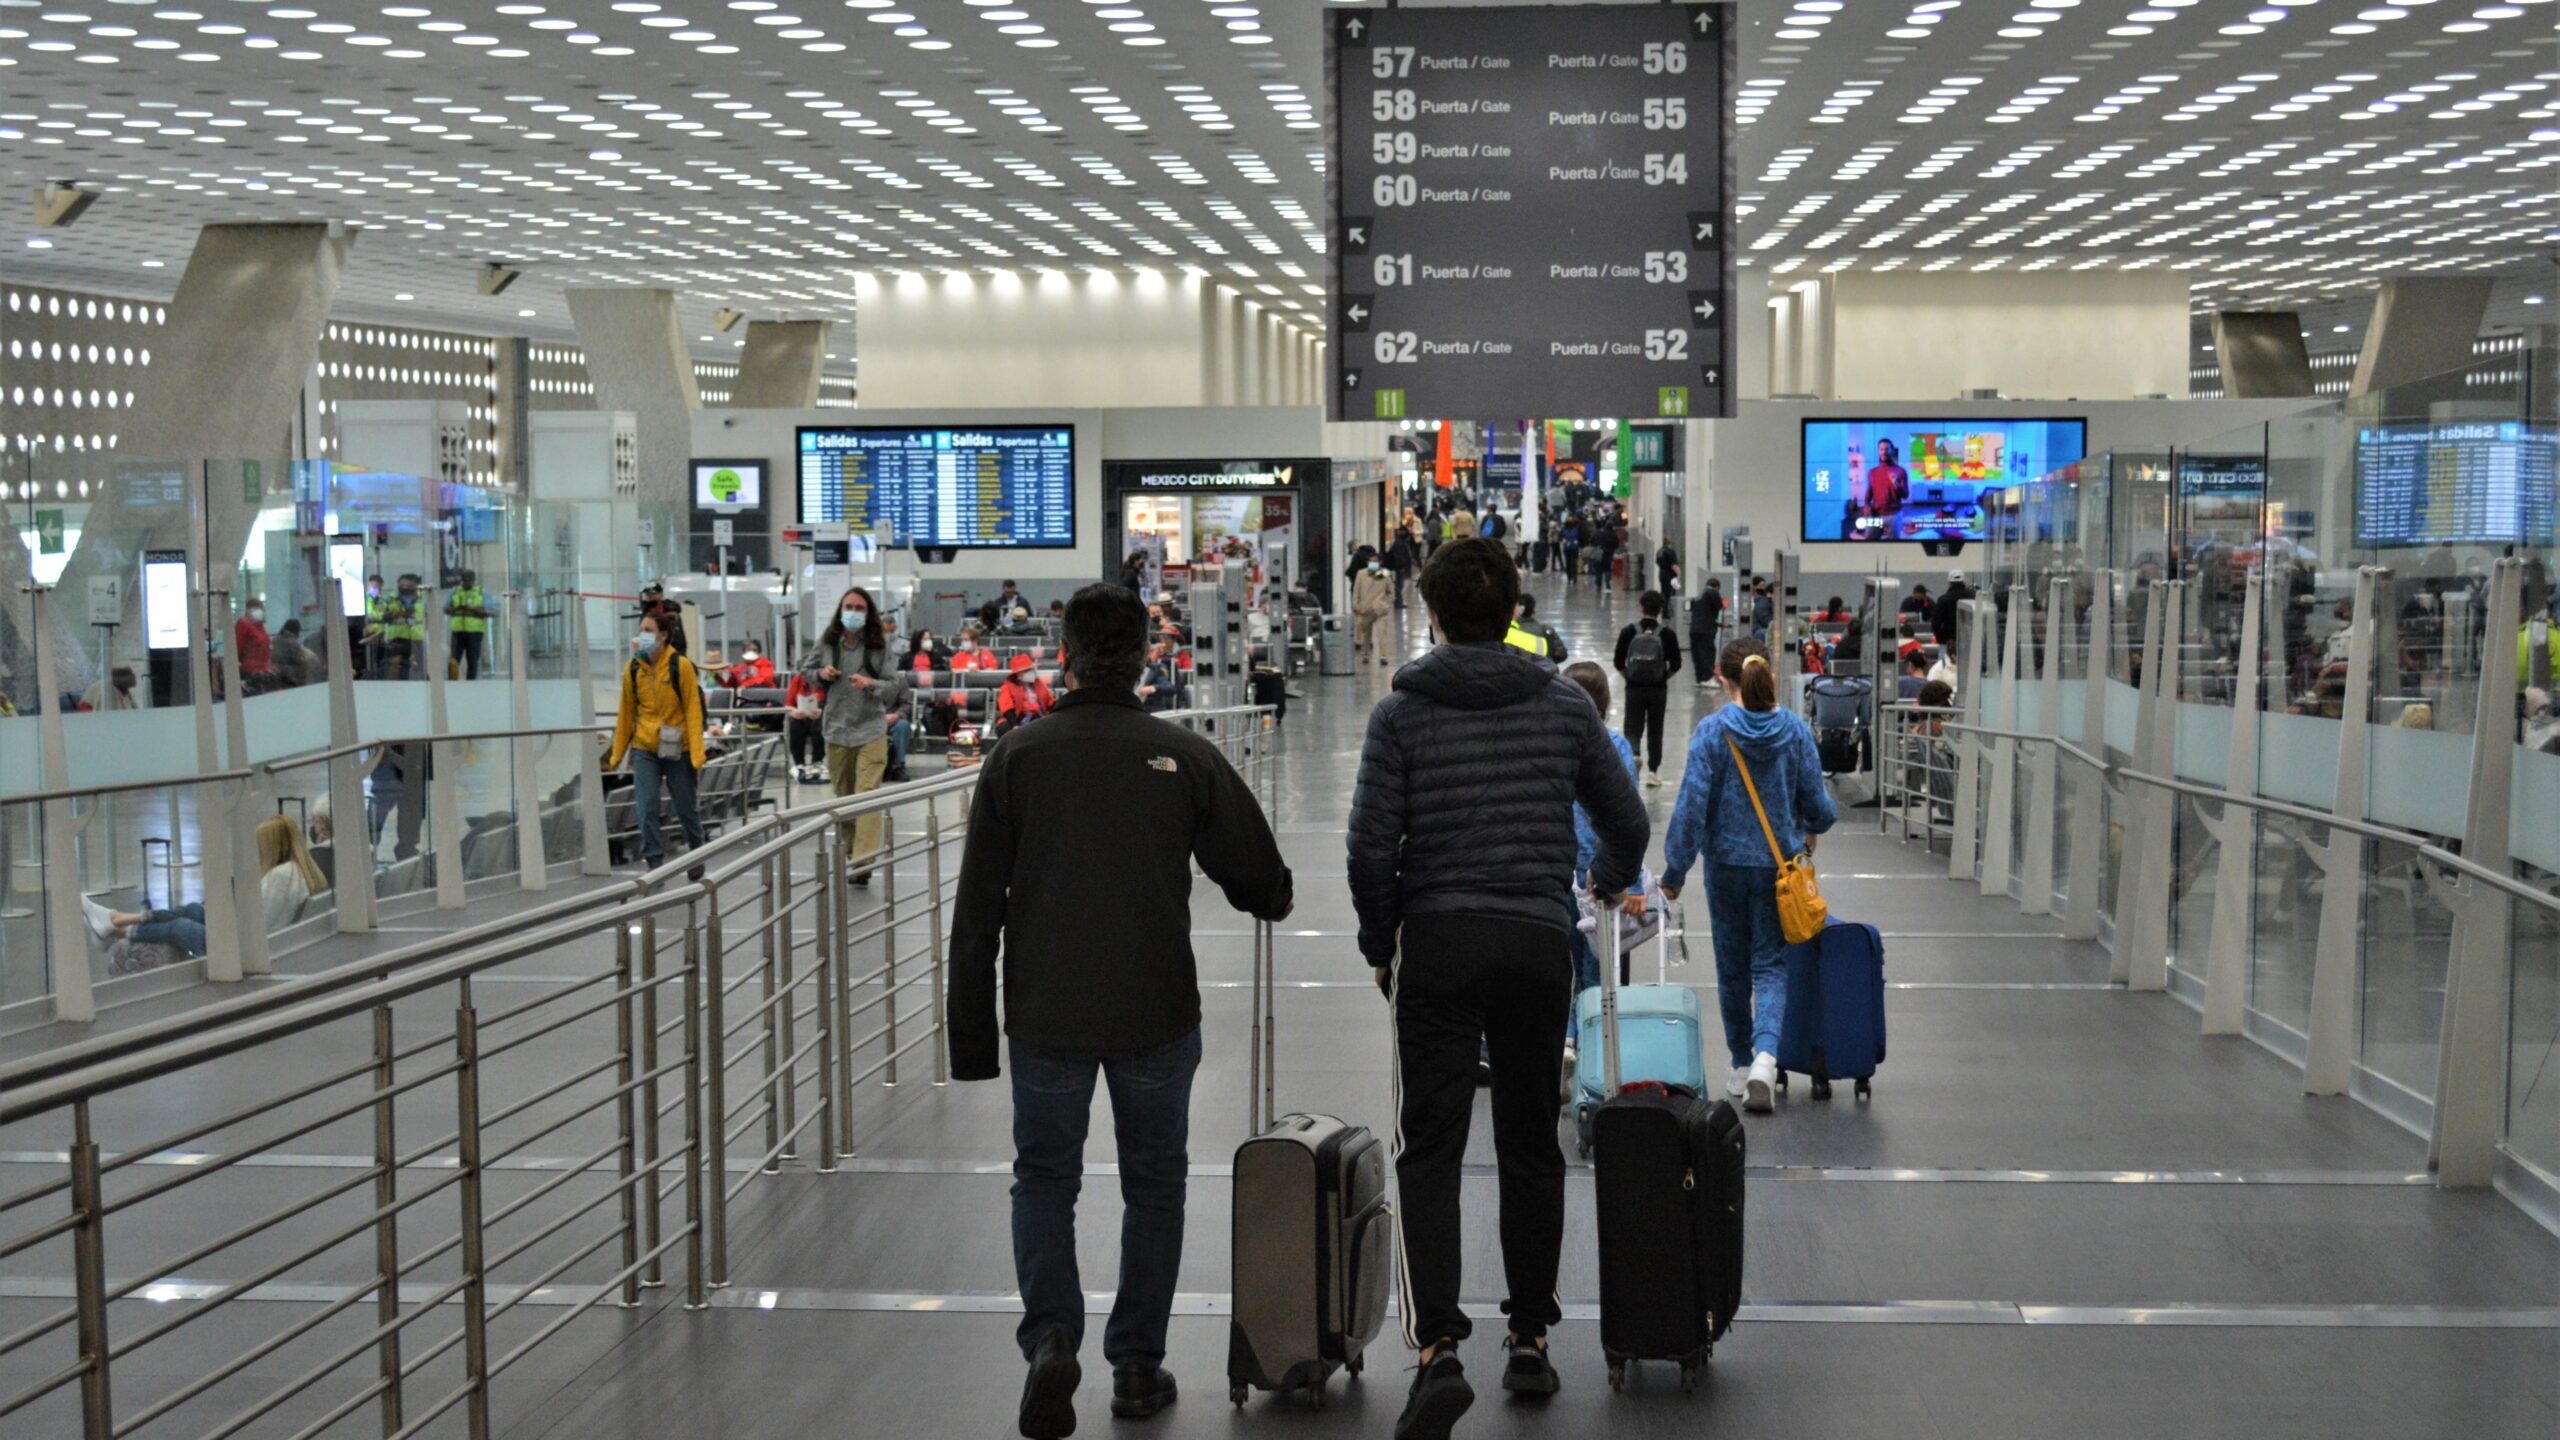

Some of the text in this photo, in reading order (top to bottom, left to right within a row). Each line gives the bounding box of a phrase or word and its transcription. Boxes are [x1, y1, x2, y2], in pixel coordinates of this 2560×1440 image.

[1373, 47, 1416, 80] 57
[1421, 57, 1470, 71] Puerta
[1481, 57, 1512, 70] Gate
[1549, 55, 1598, 69] Puerta
[1610, 55, 1640, 68] Gate
[1644, 43, 1688, 75] 56
[1374, 90, 1417, 122] 58
[1421, 101, 1470, 115] Puerta
[1481, 101, 1512, 114] Gate
[1550, 112, 1598, 126] Puerta
[1610, 112, 1641, 125] Gate
[1644, 99, 1688, 131] 55
[1375, 133, 1417, 165] 59
[1422, 145, 1470, 159] Puerta
[1482, 145, 1513, 158] Gate
[1550, 167, 1598, 181] Puerta
[1610, 167, 1641, 180] Gate
[1645, 154, 1689, 187] 54
[1375, 176, 1418, 207] 60
[1422, 189, 1470, 203] Puerta
[1482, 189, 1513, 202] Gate
[1375, 255, 1413, 287] 61
[1423, 266, 1471, 280] Puerta
[1483, 267, 1513, 280] Gate
[1551, 265, 1599, 279] Puerta
[1611, 265, 1642, 279] Gate
[1645, 252, 1688, 284] 53
[1376, 332, 1418, 364] 62
[1423, 341, 1471, 355] Puerta
[1483, 342, 1513, 355] Gate
[1551, 343, 1599, 357] Puerta
[1612, 343, 1642, 356] Gate
[1646, 329, 1689, 362] 52
[816, 434, 859, 448] Salidas
[861, 439, 902, 449] Departures
[951, 433, 994, 447] Salidas
[995, 437, 1038, 448] Departures
[1141, 474, 1187, 486] MEXICO
[723, 522, 731, 533] 2
[145, 553, 186, 563] HONOR
[105, 581, 117, 598] 4
